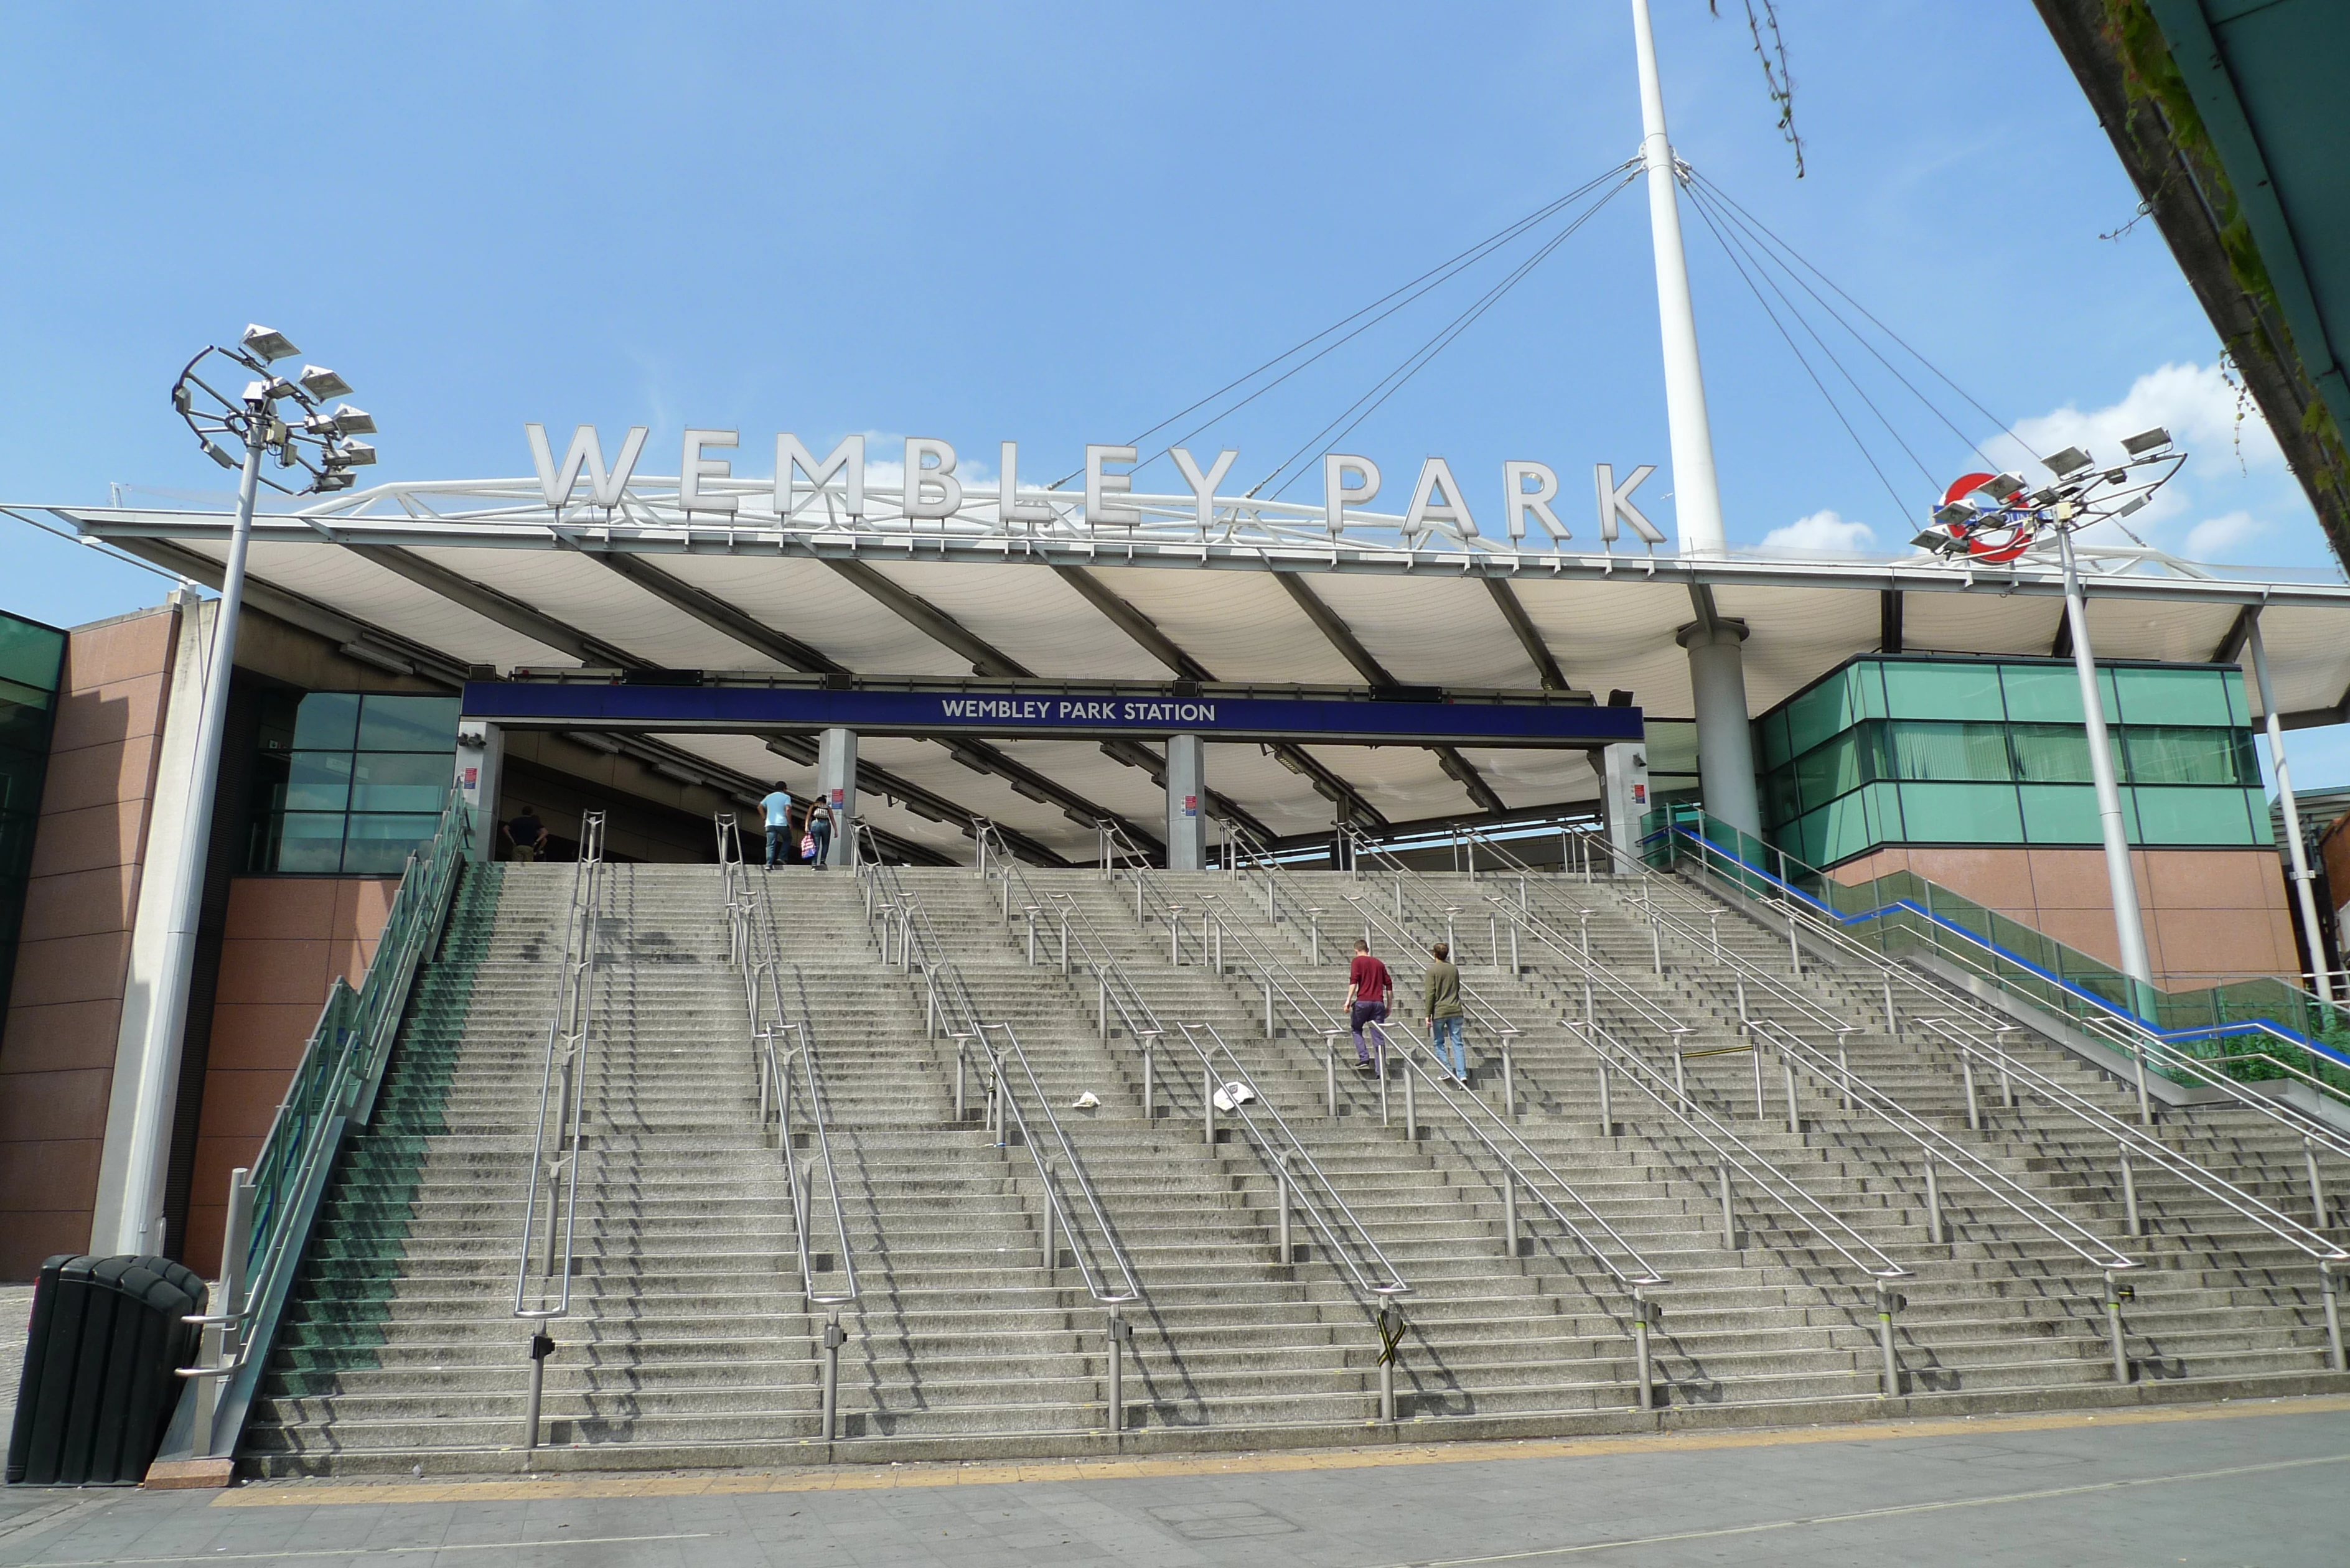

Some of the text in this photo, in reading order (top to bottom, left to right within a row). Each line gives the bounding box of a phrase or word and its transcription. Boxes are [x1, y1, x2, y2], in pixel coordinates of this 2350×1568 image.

[524, 423, 1667, 543] WEMBLEY PARK
[942, 699, 1215, 721] WEMBLEY PARK STATION
